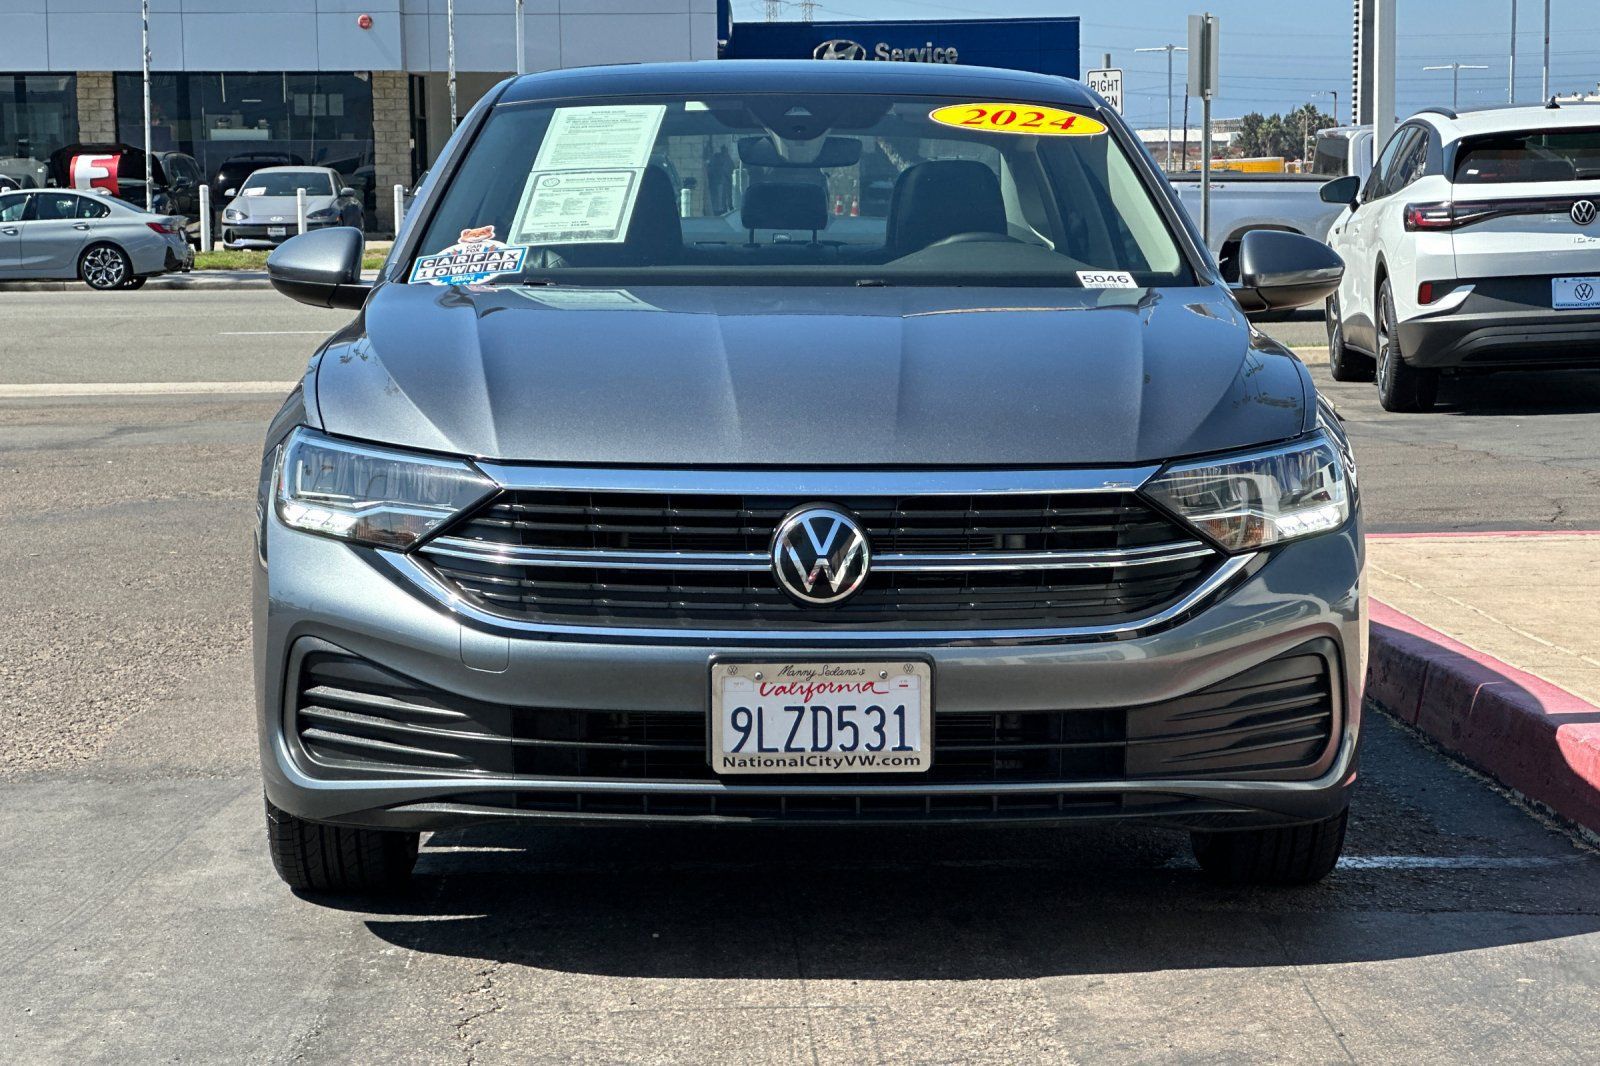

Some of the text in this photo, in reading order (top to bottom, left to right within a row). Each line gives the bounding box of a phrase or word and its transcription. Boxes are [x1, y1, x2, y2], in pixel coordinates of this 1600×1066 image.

[874, 41, 958, 63] Service
[1090, 79, 1119, 92] RIGHT
[962, 108, 1075, 130] 2024
[422, 252, 517, 268] CARFAX
[419, 261, 516, 278] 1 OWNER
[1082, 275, 1129, 284] 5046
[777, 664, 816, 681] Manny
[759, 680, 889, 703] California
[730, 704, 914, 753] 9LZD531
[723, 754, 921, 769] NationalCityVW.com
